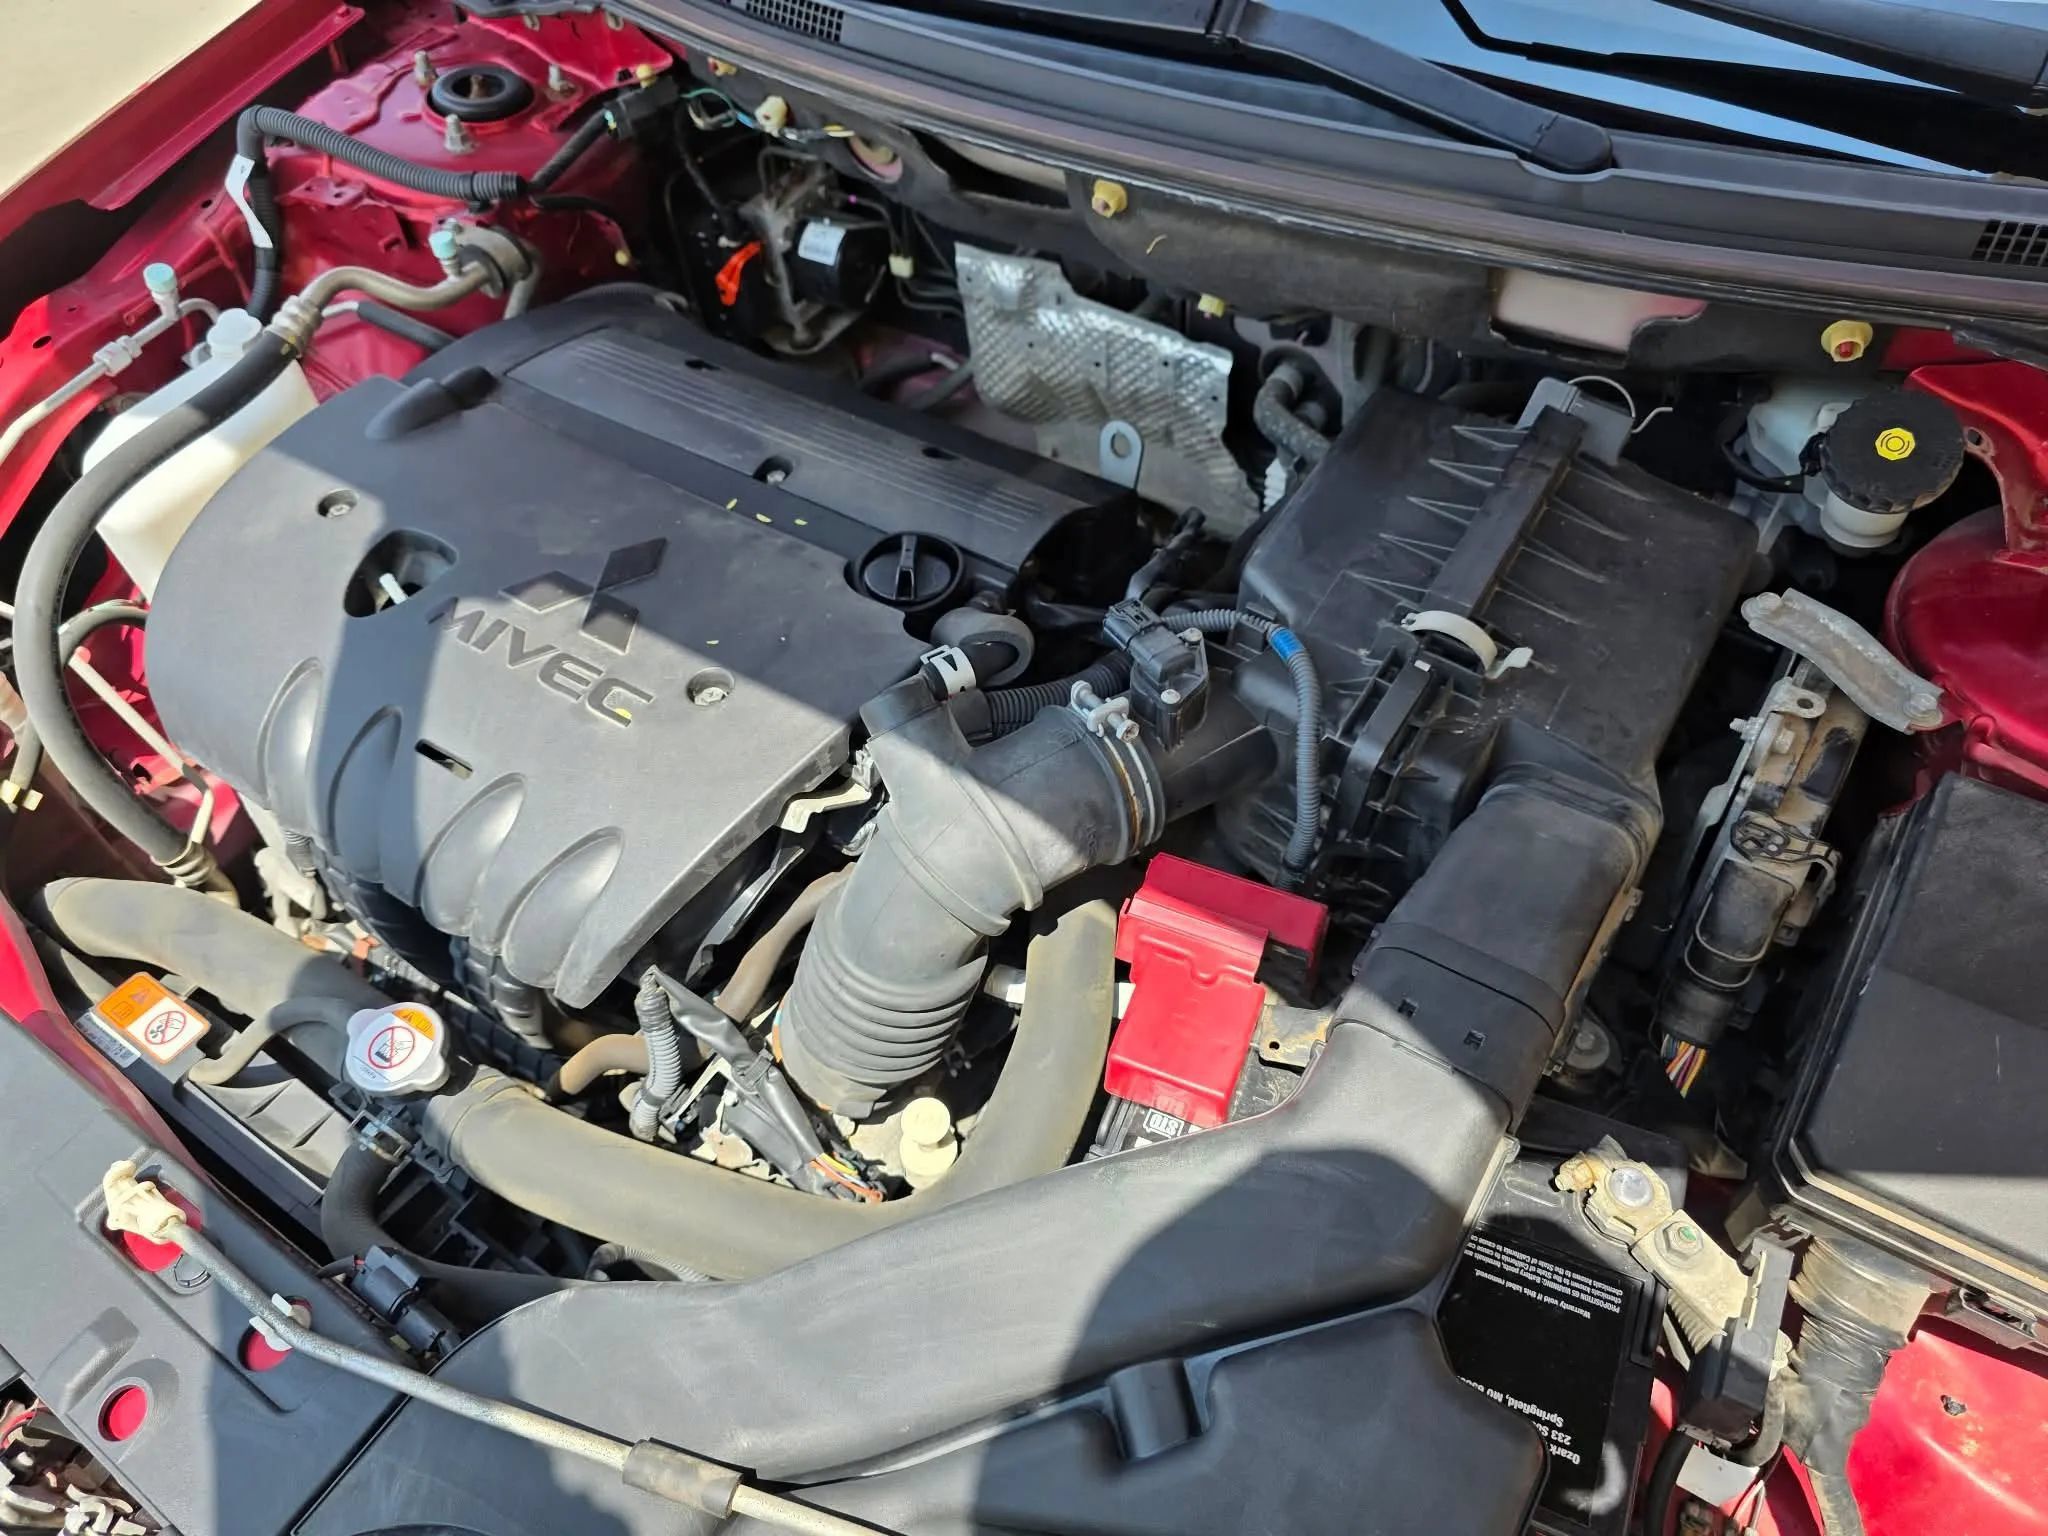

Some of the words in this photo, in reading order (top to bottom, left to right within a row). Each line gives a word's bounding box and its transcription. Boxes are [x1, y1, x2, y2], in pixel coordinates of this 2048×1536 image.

[426, 596, 656, 728] MIVEC
[1473, 1252, 1501, 1267] terminals
[1501, 1261, 1519, 1273] posts,
[1474, 1268, 1505, 1285] removed.
[1519, 1268, 1541, 1283] Battery
[1505, 1280, 1522, 1292] label
[1523, 1287, 1536, 1298] this
[1541, 1277, 1571, 1295] WARNING:
[1536, 1292, 1543, 1300] if
[1543, 1295, 1558, 1305] void
[1579, 1292, 1620, 1313] PROPOSITION
[1559, 1300, 1590, 1318] Warranty
[1505, 1394, 1563, 1427] Springfield,
[1550, 1429, 1571, 1445] 233
[1548, 1443, 1580, 1464] Ozark
